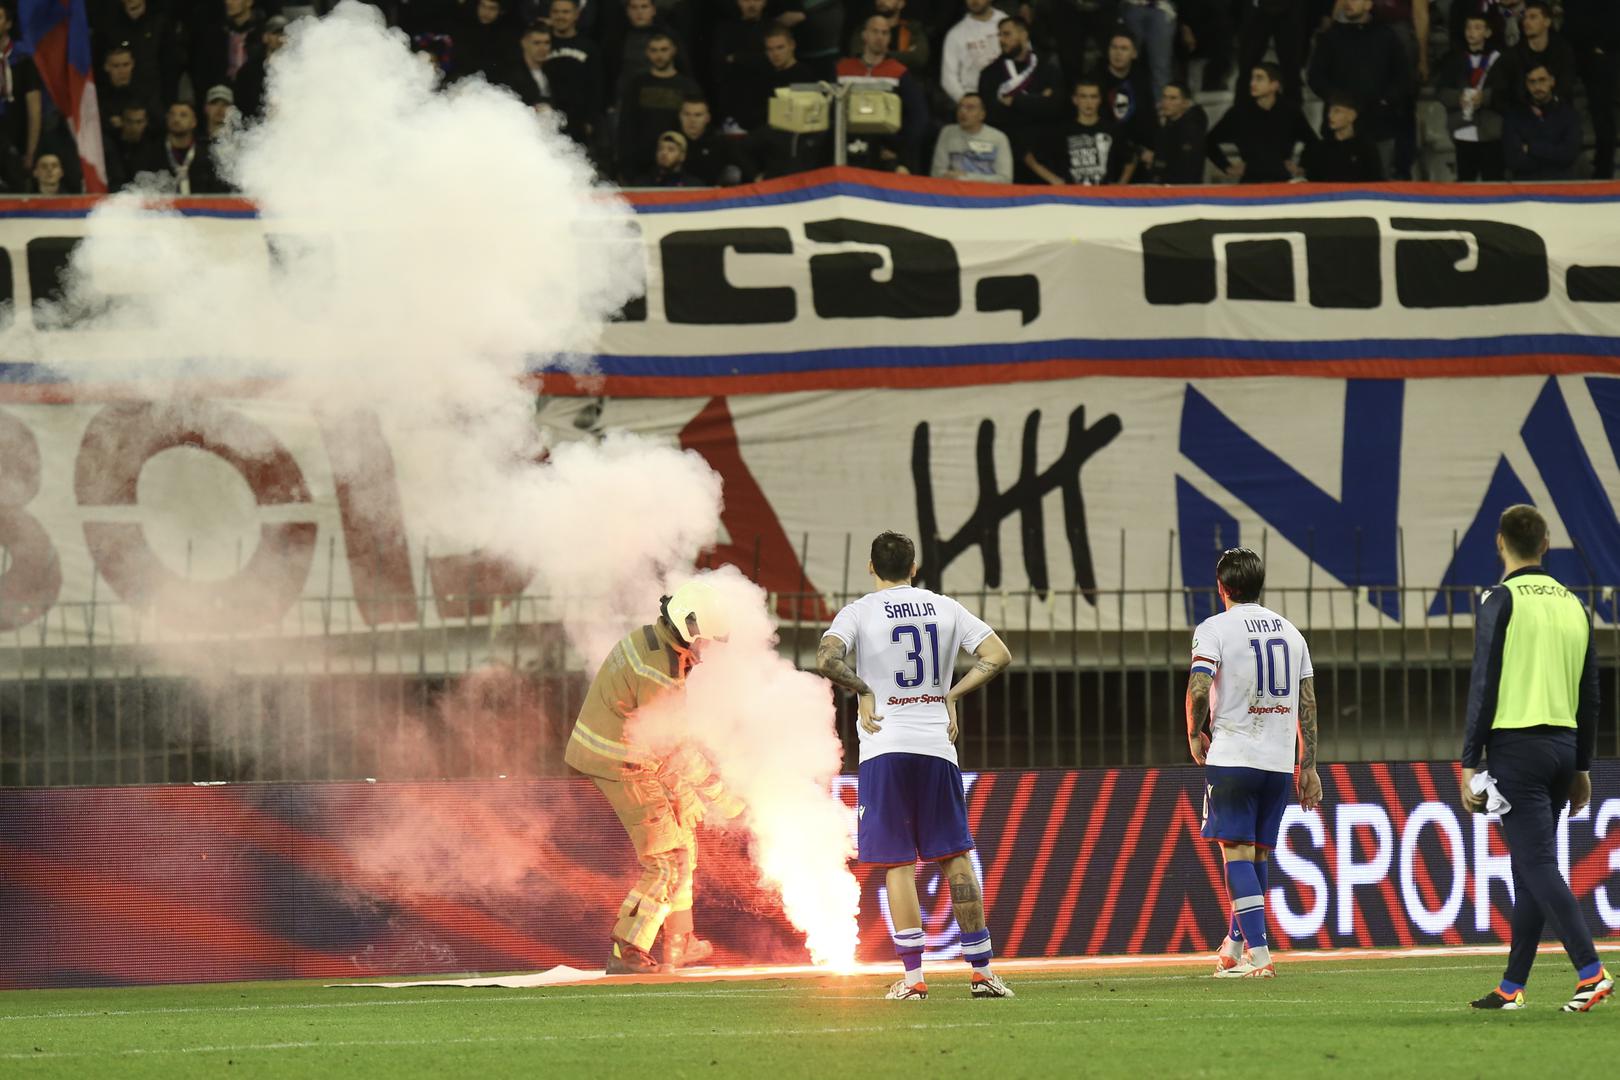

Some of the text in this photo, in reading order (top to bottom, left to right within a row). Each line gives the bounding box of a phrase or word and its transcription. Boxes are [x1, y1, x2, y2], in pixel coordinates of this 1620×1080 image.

[1178, 376, 1620, 624] NA
[884, 601, 937, 619] ŠARLIJA
[1244, 619, 1284, 633] LIVAJA
[890, 622, 941, 689] 31
[1248, 637, 1291, 698] 10
